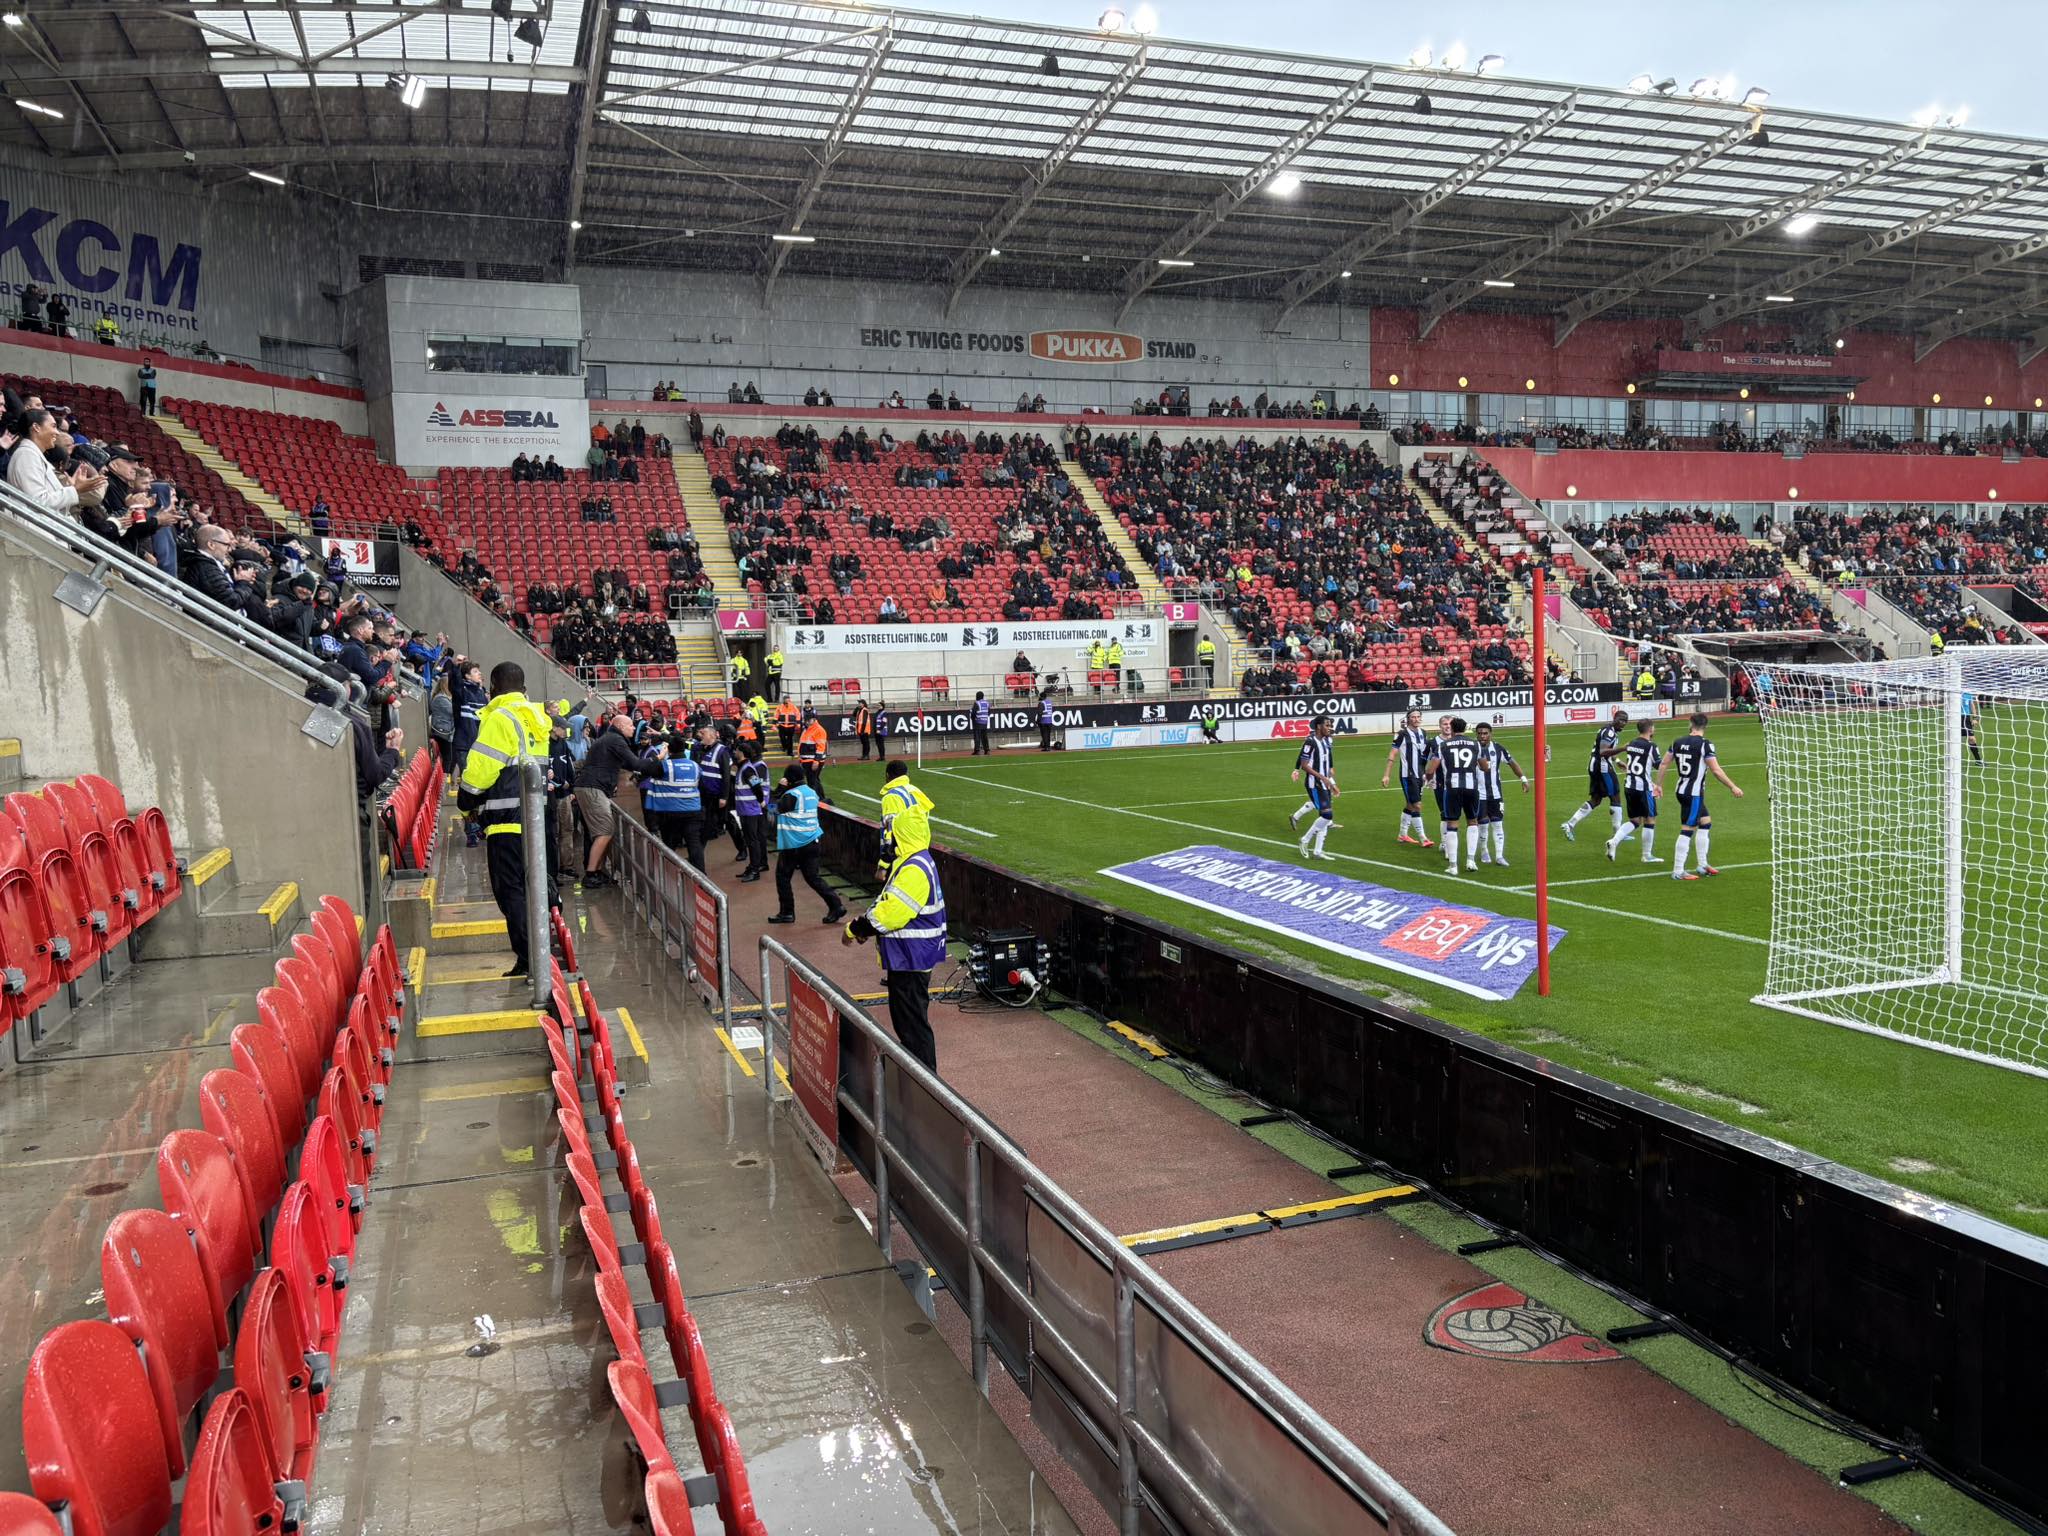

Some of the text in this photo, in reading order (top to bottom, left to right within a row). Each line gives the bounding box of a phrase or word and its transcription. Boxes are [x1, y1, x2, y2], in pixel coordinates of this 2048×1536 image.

[0, 199, 202, 313] KCM
[57, 291, 199, 332] management
[860, 328, 1196, 359] ERIC TWIGG FOODS PUKKA STAND
[1722, 356, 1736, 364] The
[1770, 357, 1785, 366] New
[1786, 357, 1802, 366] York
[1803, 358, 1832, 367] Stadium
[459, 409, 559, 428] AESSEAL
[426, 435, 560, 445] EXPERIENCE THE EXCEPTIONAL
[735, 611, 750, 628] A
[1173, 605, 1184, 620] B
[845, 631, 948, 645] ASDSTREETLIGHTING.COM
[1012, 629, 1108, 641] ASDSTREETLIGHTING.COM
[1450, 687, 1599, 708] ASDLIGHTIG.COM
[1189, 698, 1356, 720] ASDLIGHTING.COM
[894, 710, 1083, 733] ASDLIGTING.OM
[1271, 717, 1358, 738] AESAL
[1084, 733, 1109, 745] TMG
[1160, 729, 1184, 740] TMG
[1450, 748, 1473, 768] 19
[1675, 753, 1692, 776] 15
[1180, 858, 1279, 890] BETTING
[1291, 887, 1364, 916] UK'S
[1340, 899, 1409, 930] THE
[1403, 916, 1538, 971] sky bet
